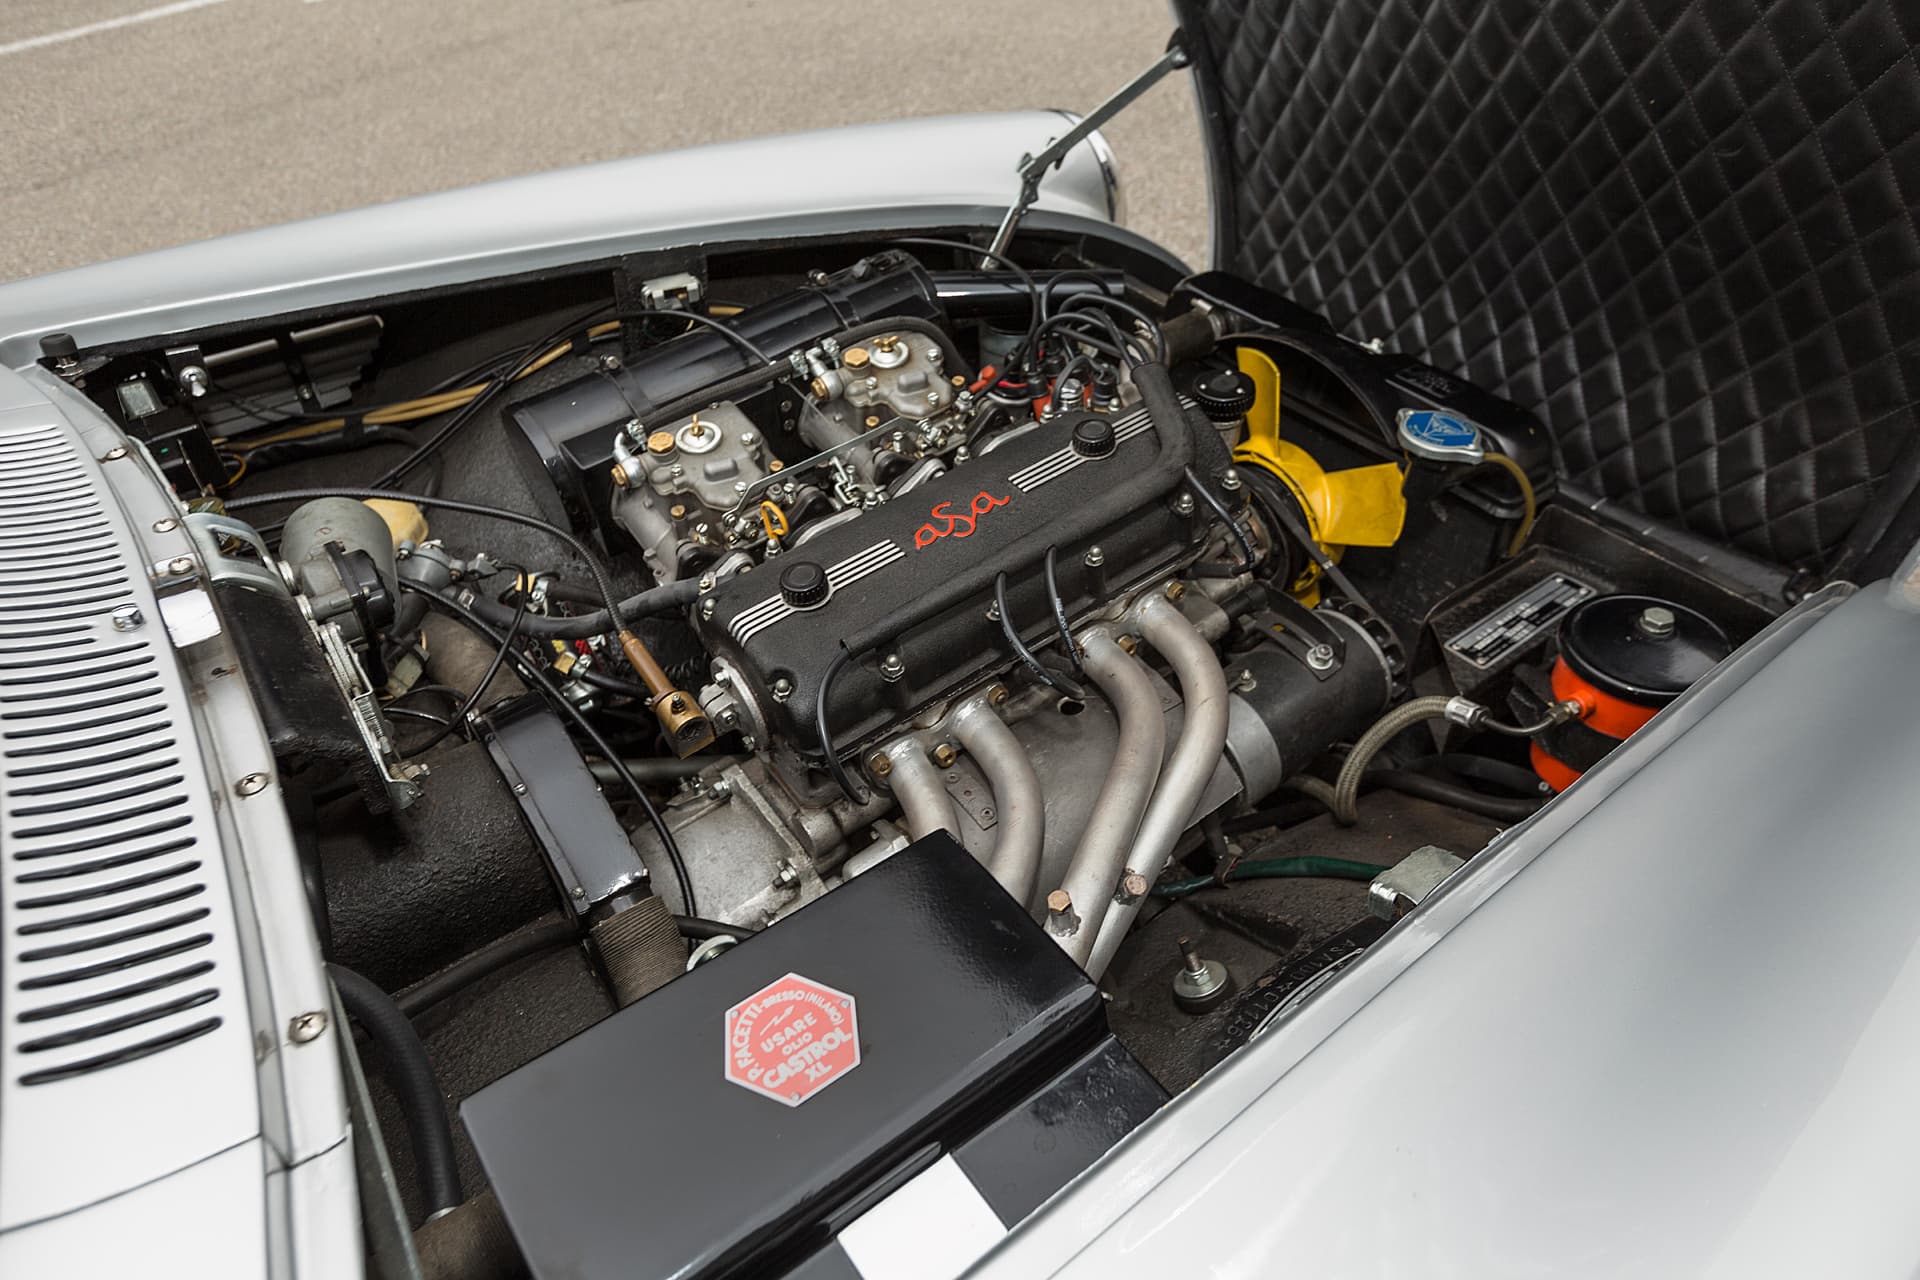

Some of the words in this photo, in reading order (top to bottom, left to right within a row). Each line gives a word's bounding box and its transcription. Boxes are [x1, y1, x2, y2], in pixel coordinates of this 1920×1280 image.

[760, 1012, 817, 1053] USARE
[782, 1032, 812, 1055] OLIO
[763, 1027, 852, 1088] CASTROL
[805, 1062, 832, 1083] XL
